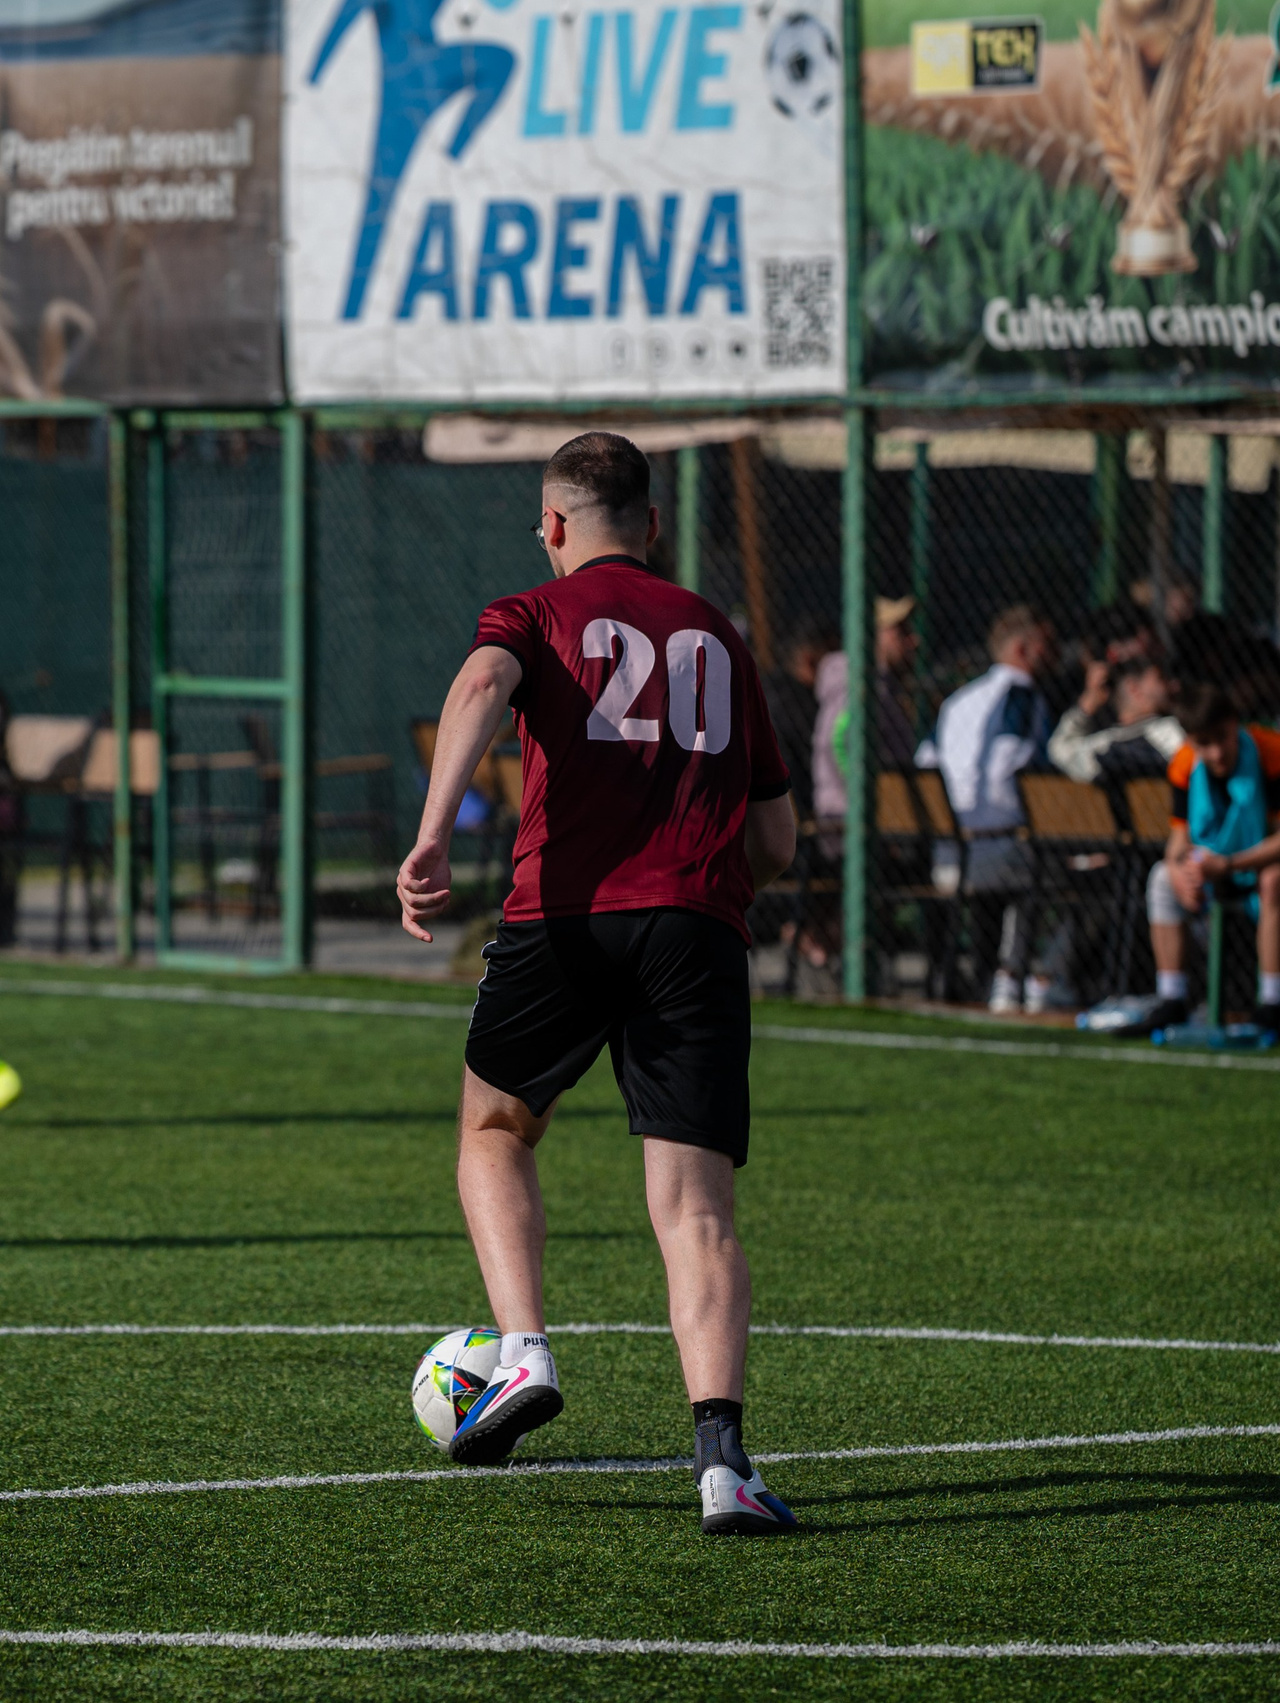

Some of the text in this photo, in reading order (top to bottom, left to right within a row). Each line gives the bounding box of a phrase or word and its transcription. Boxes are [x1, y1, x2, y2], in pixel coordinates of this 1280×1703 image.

[522, 5, 743, 139] LIVE
[394, 190, 748, 322] ARENA
[982, 293, 1149, 350] Cultivăm
[583, 618, 731, 754] 20
